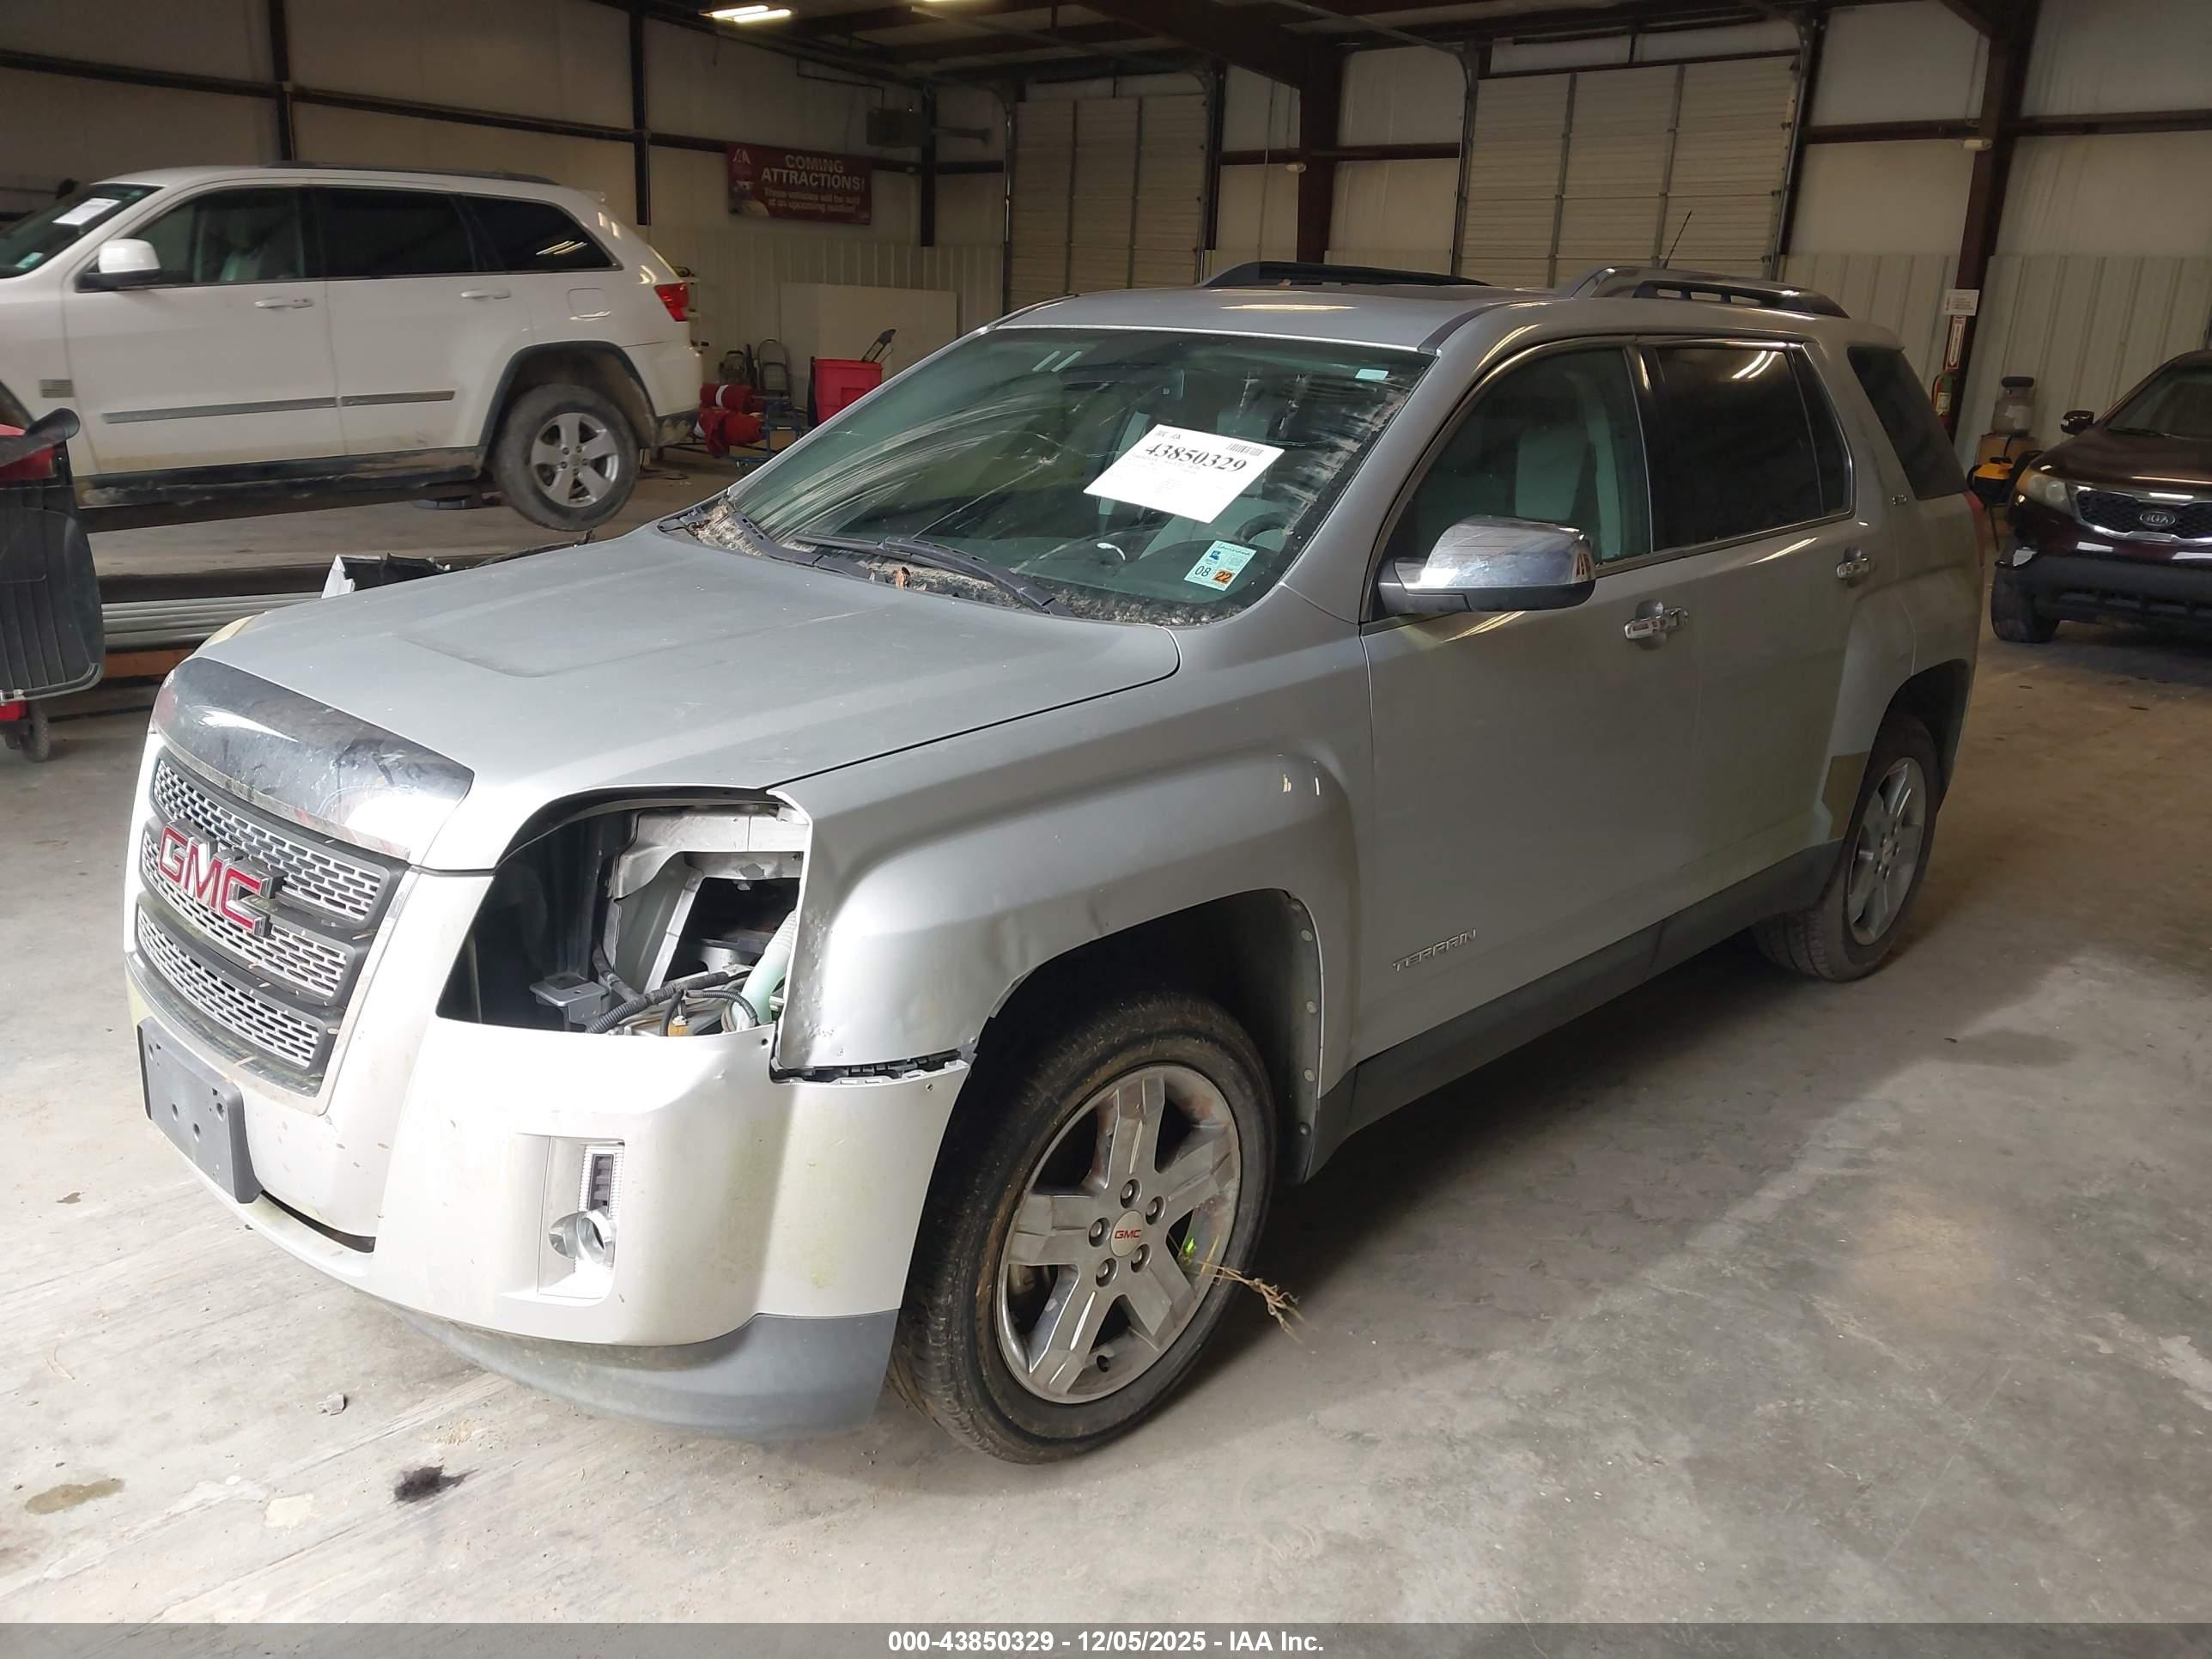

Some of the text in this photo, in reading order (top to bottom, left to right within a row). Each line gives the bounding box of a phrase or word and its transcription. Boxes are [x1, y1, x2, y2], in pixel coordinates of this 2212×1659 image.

[784, 154, 844, 173] COMING
[761, 167, 866, 191] ATTRACTIONS!
[1145, 442, 1249, 472] 43850329
[1194, 565, 1212, 577] 08
[1213, 570, 1233, 584] 22
[158, 824, 273, 936] GMC
[1392, 927, 1477, 972] TERRAIN
[1115, 1229, 1142, 1239] GMC
